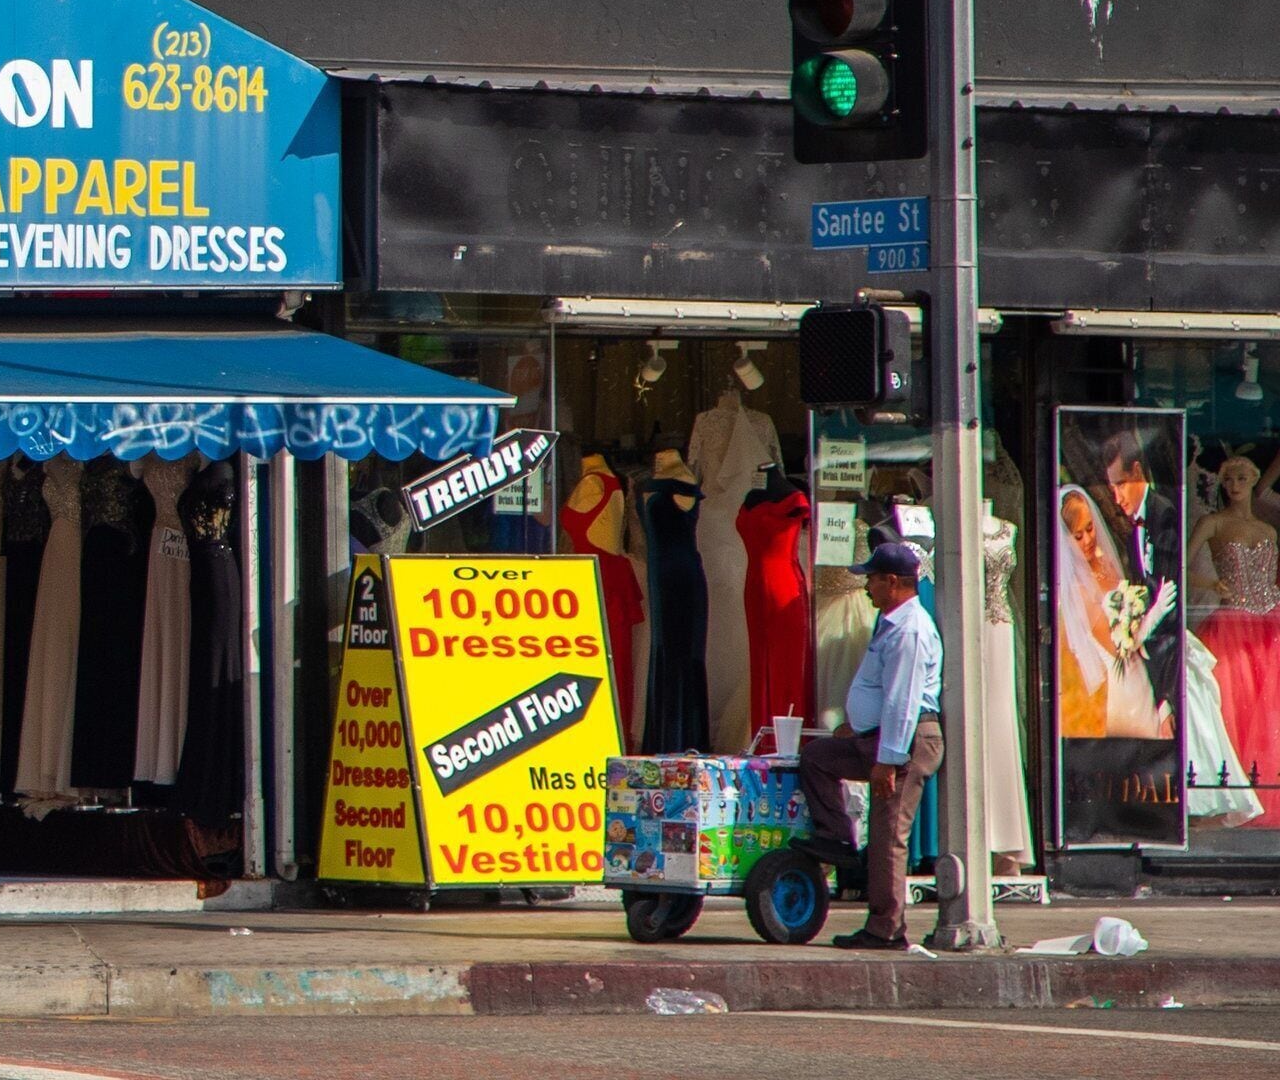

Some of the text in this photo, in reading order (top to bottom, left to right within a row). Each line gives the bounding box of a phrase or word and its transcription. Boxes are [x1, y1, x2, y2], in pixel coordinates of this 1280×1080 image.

[152, 21, 212, 62] (213)
[123, 63, 269, 114] 623-8614
[817, 202, 920, 237] Santee St
[149, 222, 288, 273] DRESSES
[878, 247, 920, 269] 900 S
[413, 435, 551, 521] TRENDY TOO
[822, 533, 850, 543] Wanted
[826, 517, 847, 529] Help
[361, 575, 375, 600] 2
[452, 566, 533, 582] Over
[359, 604, 377, 622] nd
[422, 588, 580, 626] 10,000
[351, 627, 388, 645] Floor
[410, 627, 600, 659] Dresses
[347, 680, 392, 708] Over
[338, 721, 402, 753] 10,000
[430, 679, 584, 780] Second Floor
[333, 760, 410, 790] Dresses
[529, 766, 607, 791] Mas de
[334, 799, 406, 829] Second
[457, 802, 602, 840] 10,000
[345, 840, 396, 869] Floor
[440, 843, 604, 876] Vestido
